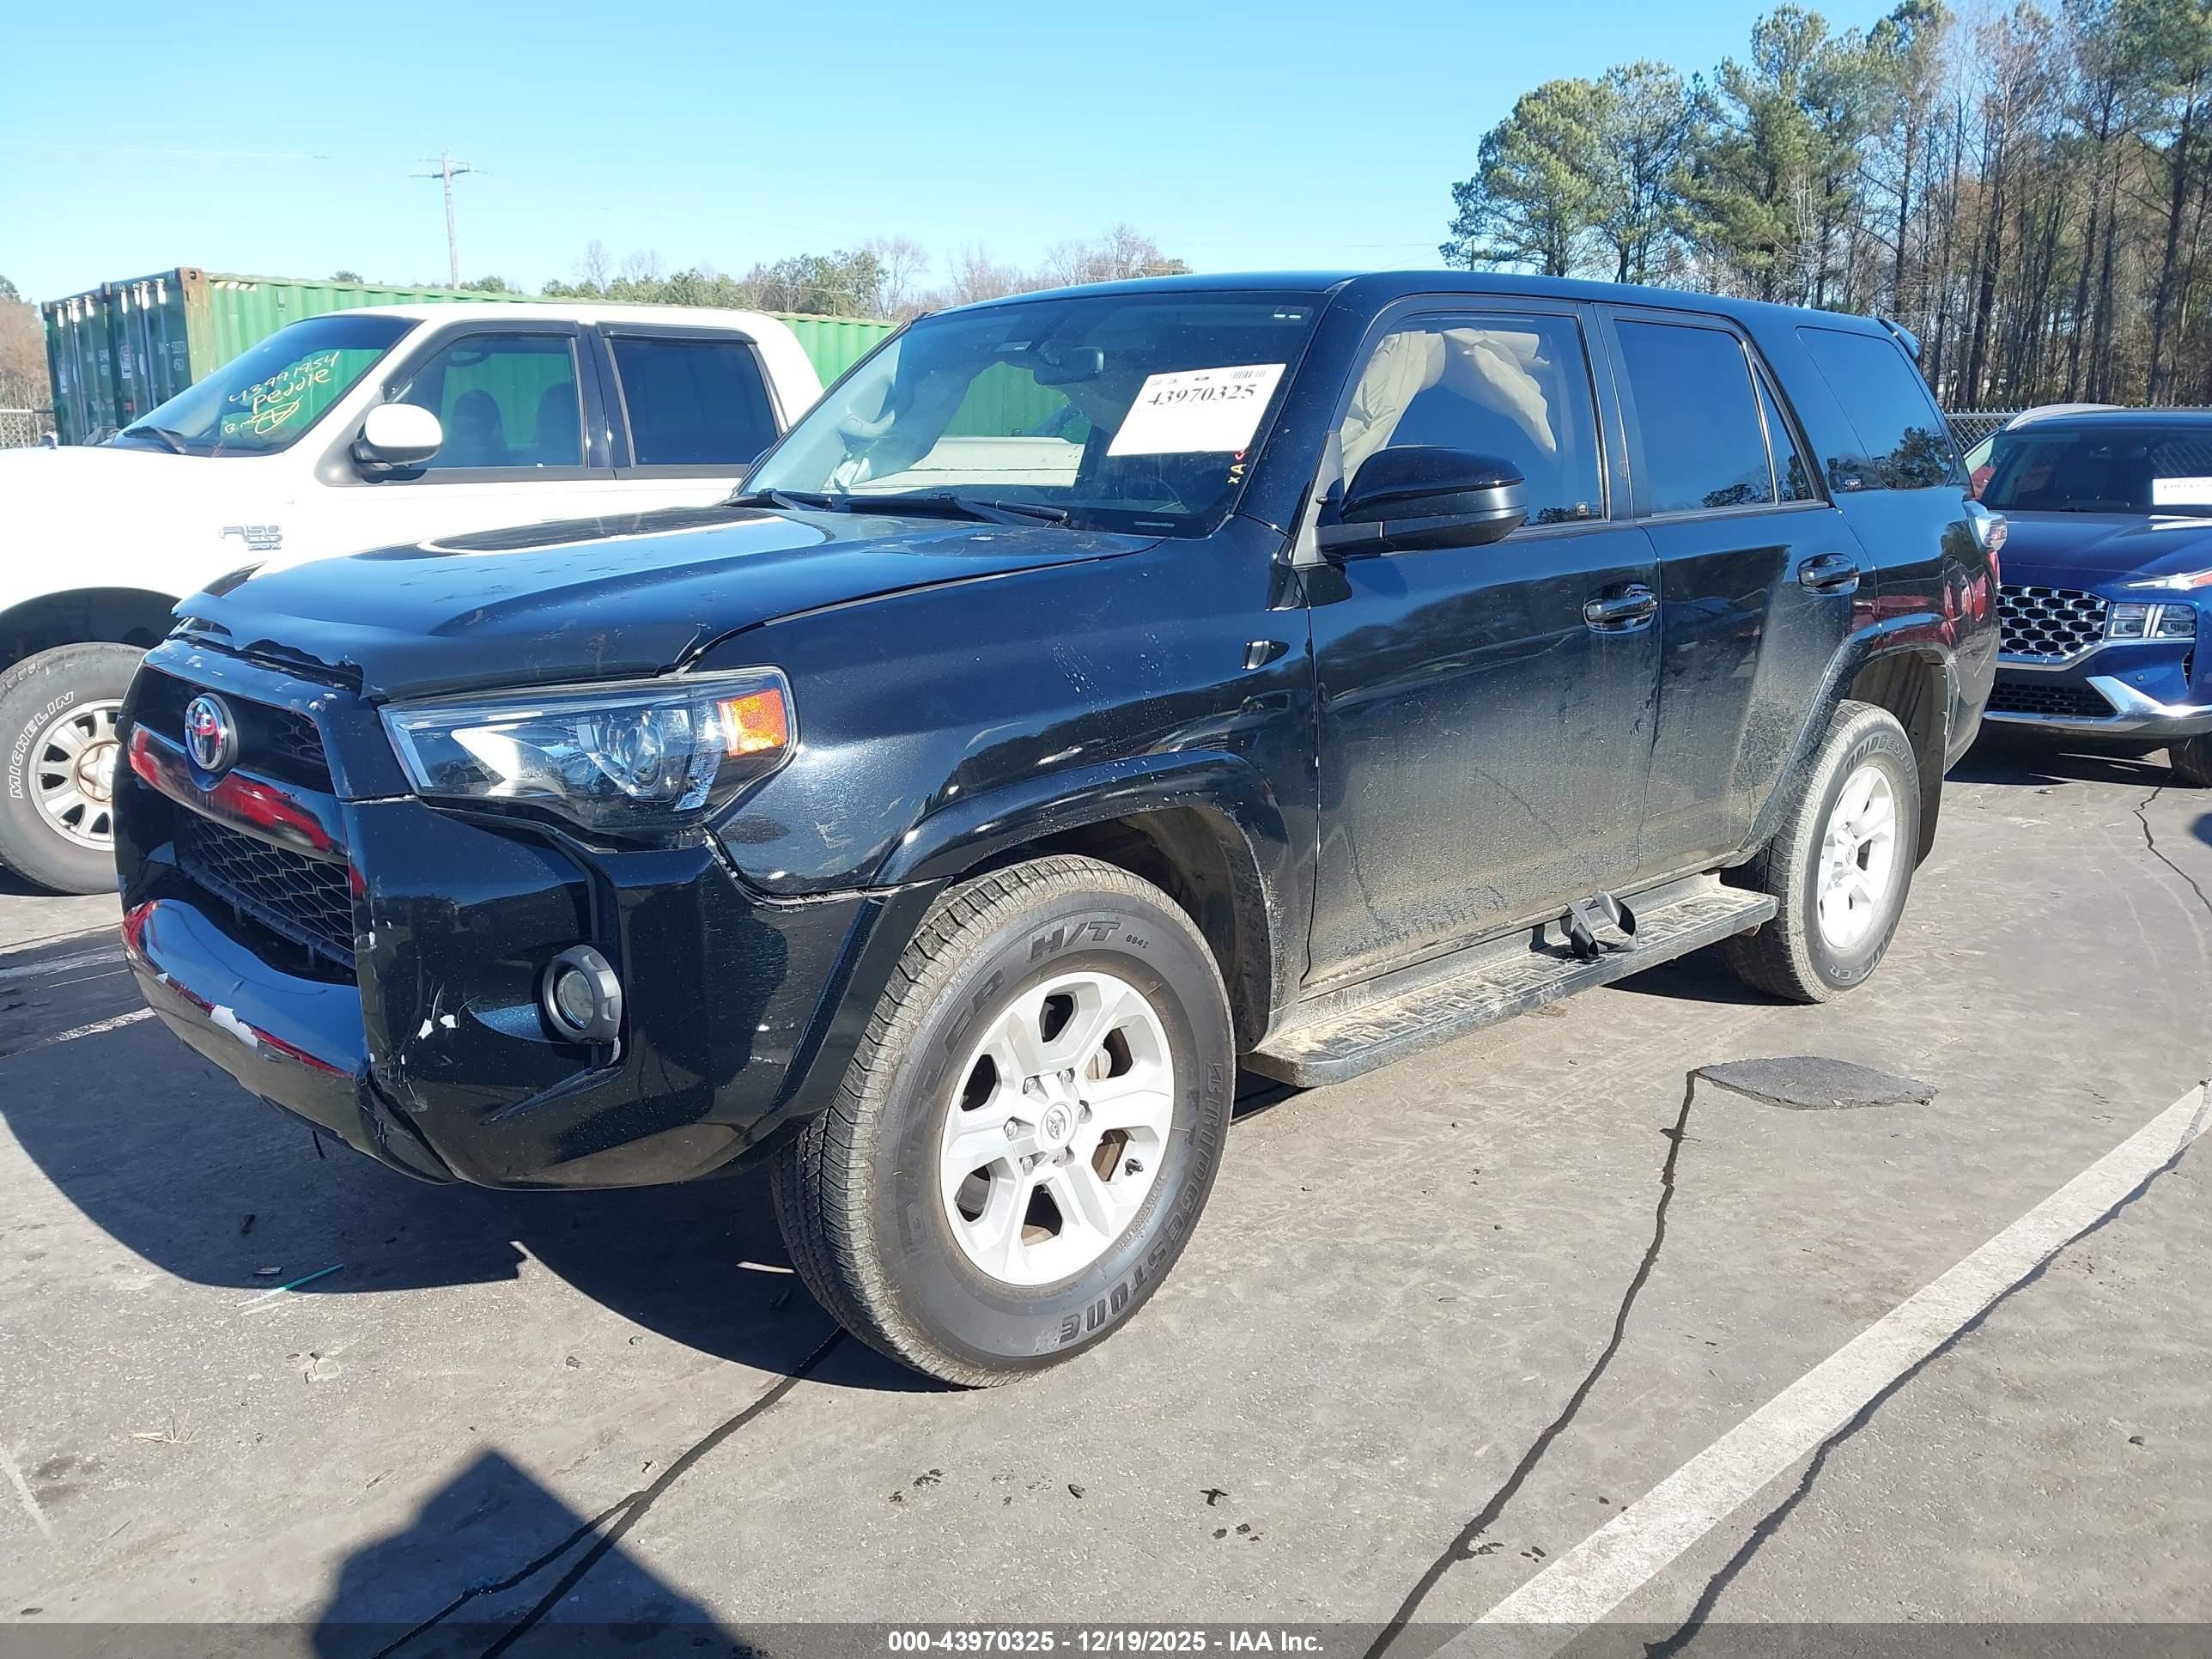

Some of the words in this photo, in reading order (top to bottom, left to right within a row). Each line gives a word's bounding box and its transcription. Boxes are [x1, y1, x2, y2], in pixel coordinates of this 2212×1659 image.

[1147, 384, 1257, 405] 43970325
[9, 691, 74, 799] MICHELIN
[1030, 921, 1121, 963] H/T
